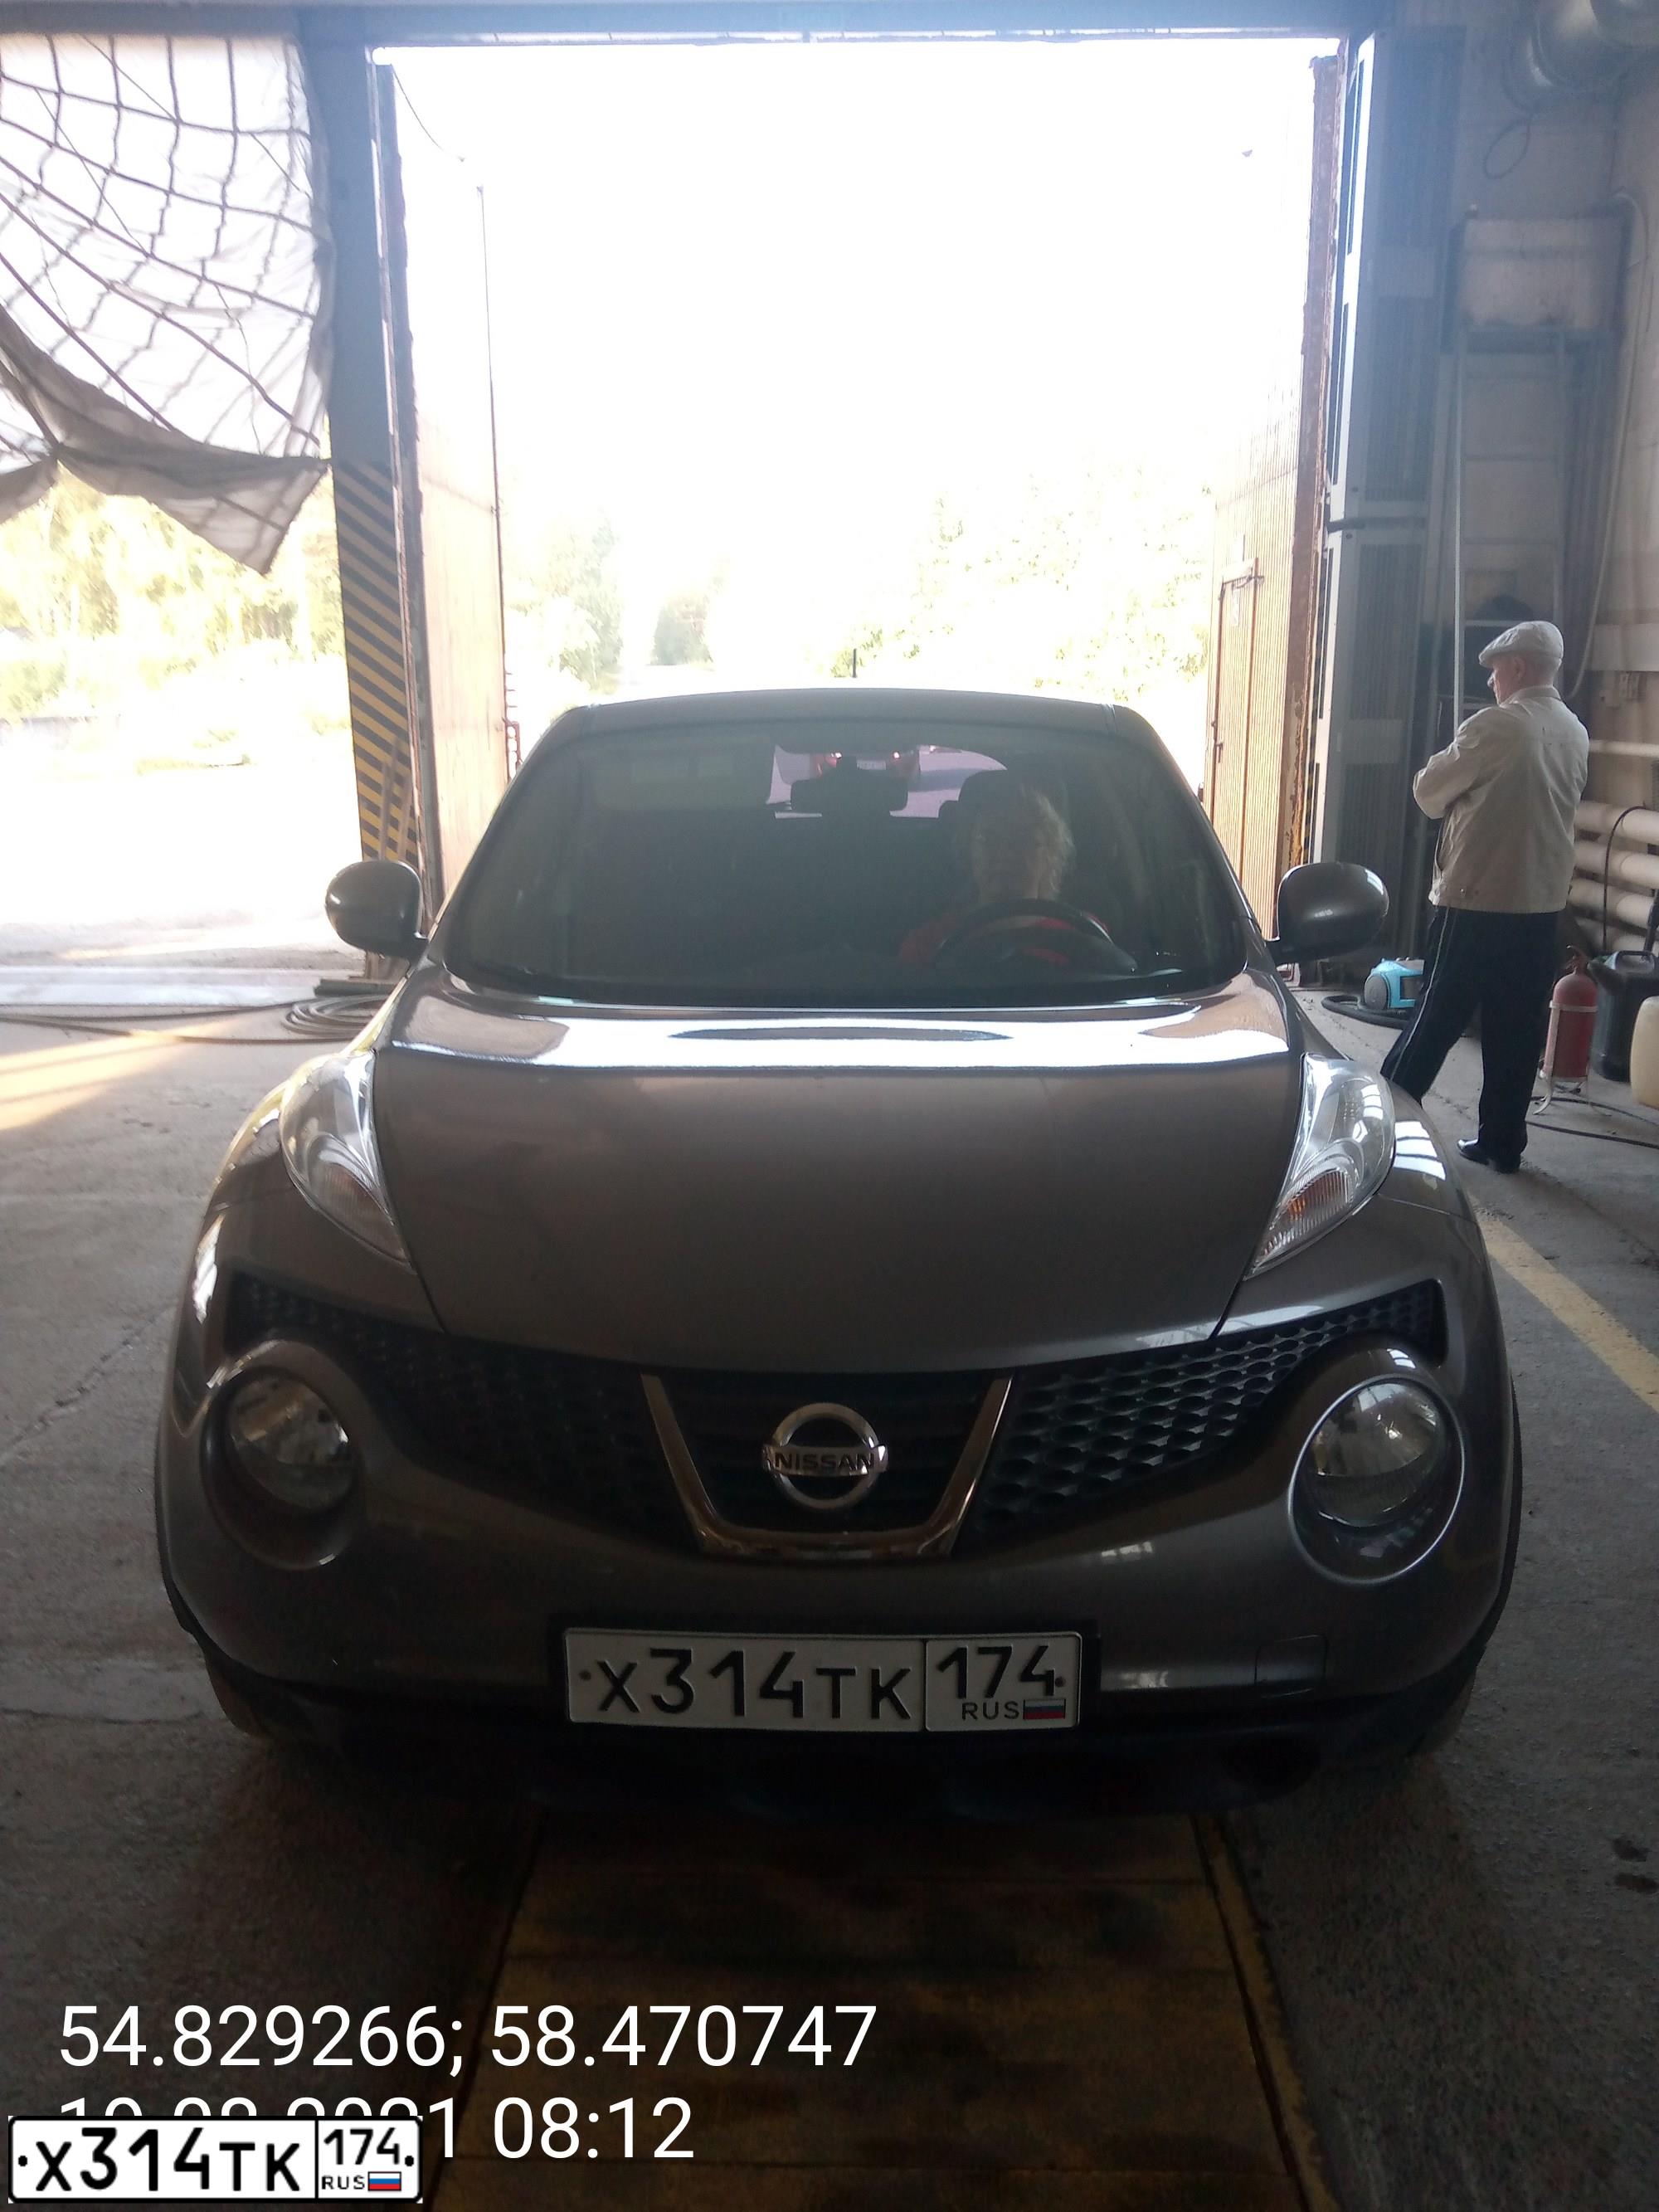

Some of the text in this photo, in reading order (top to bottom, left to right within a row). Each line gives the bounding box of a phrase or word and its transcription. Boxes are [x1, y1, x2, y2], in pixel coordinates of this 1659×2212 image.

[775, 1453, 874, 1470] NISSAN
[937, 1645, 1055, 1698] 174
[962, 1699, 1019, 1720] RUS
